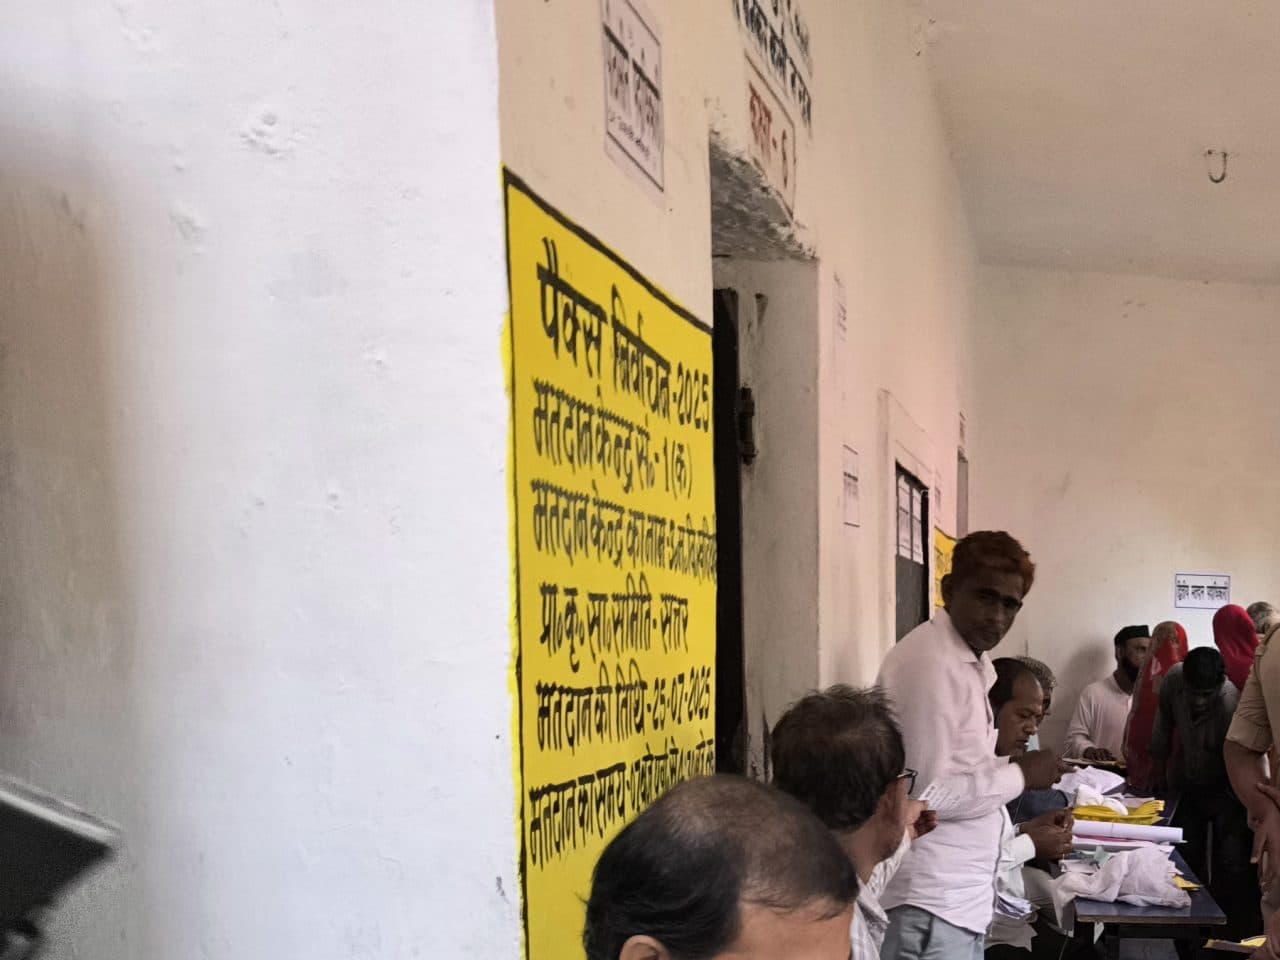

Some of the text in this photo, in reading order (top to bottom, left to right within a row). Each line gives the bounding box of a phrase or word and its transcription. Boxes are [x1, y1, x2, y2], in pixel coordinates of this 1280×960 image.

[532, 377, 594, 476] मतदान
[530, 479, 590, 566] मतदान
[626, 507, 646, 565] का
[536, 680, 593, 754] मतदान
[594, 660, 613, 746] की
[614, 657, 648, 745] तिथि
[528, 778, 577, 870] मतदान
[577, 774, 595, 849] का
[594, 762, 626, 839] समय
